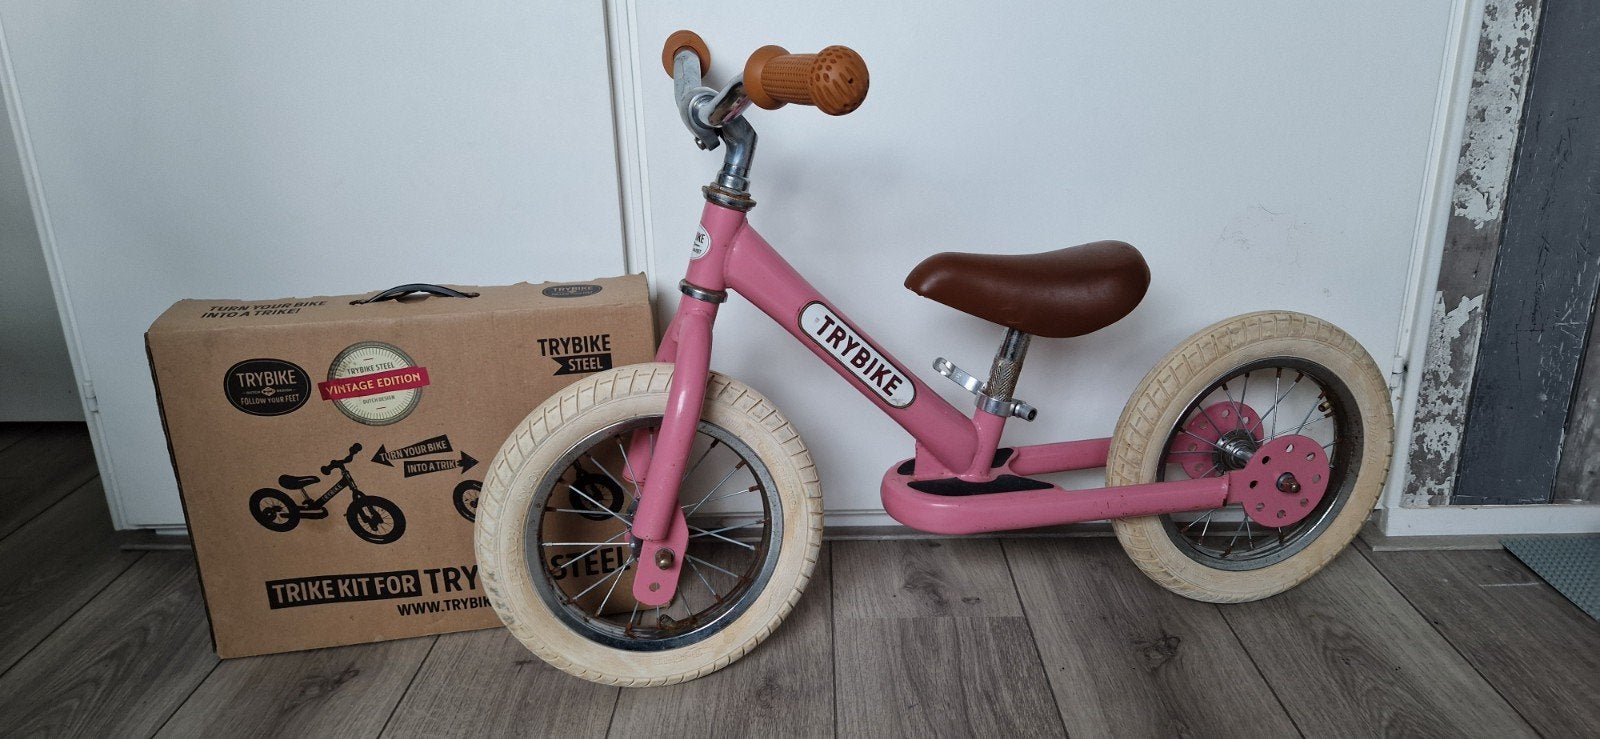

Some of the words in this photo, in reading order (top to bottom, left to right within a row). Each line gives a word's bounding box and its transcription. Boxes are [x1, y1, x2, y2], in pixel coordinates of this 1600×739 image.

[254, 308, 302, 317] TRIKE!
[536, 334, 612, 357] TRYBIKE
[568, 358, 604, 372] STEEL
[816, 314, 903, 397] TRYBIKE
[347, 364, 375, 375] TRYBIKE
[375, 362, 395, 371] STEEL
[236, 369, 297, 388] TRYBIKE
[325, 380, 375, 395] VINTAGE
[376, 372, 421, 388] EDITION
[241, 397, 267, 405] FOLLOW
[285, 393, 300, 402] FEET
[379, 449, 403, 462] TURN
[403, 445, 427, 457] YOUR
[427, 440, 448, 452] BIKE
[407, 462, 428, 474] INTO
[428, 462, 436, 471] A
[436, 459, 460, 470] TRIKE
[272, 579, 335, 604] TRIKE
[337, 576, 371, 598] KIT
[374, 574, 416, 595] FOR
[550, 546, 631, 581] STEEL
